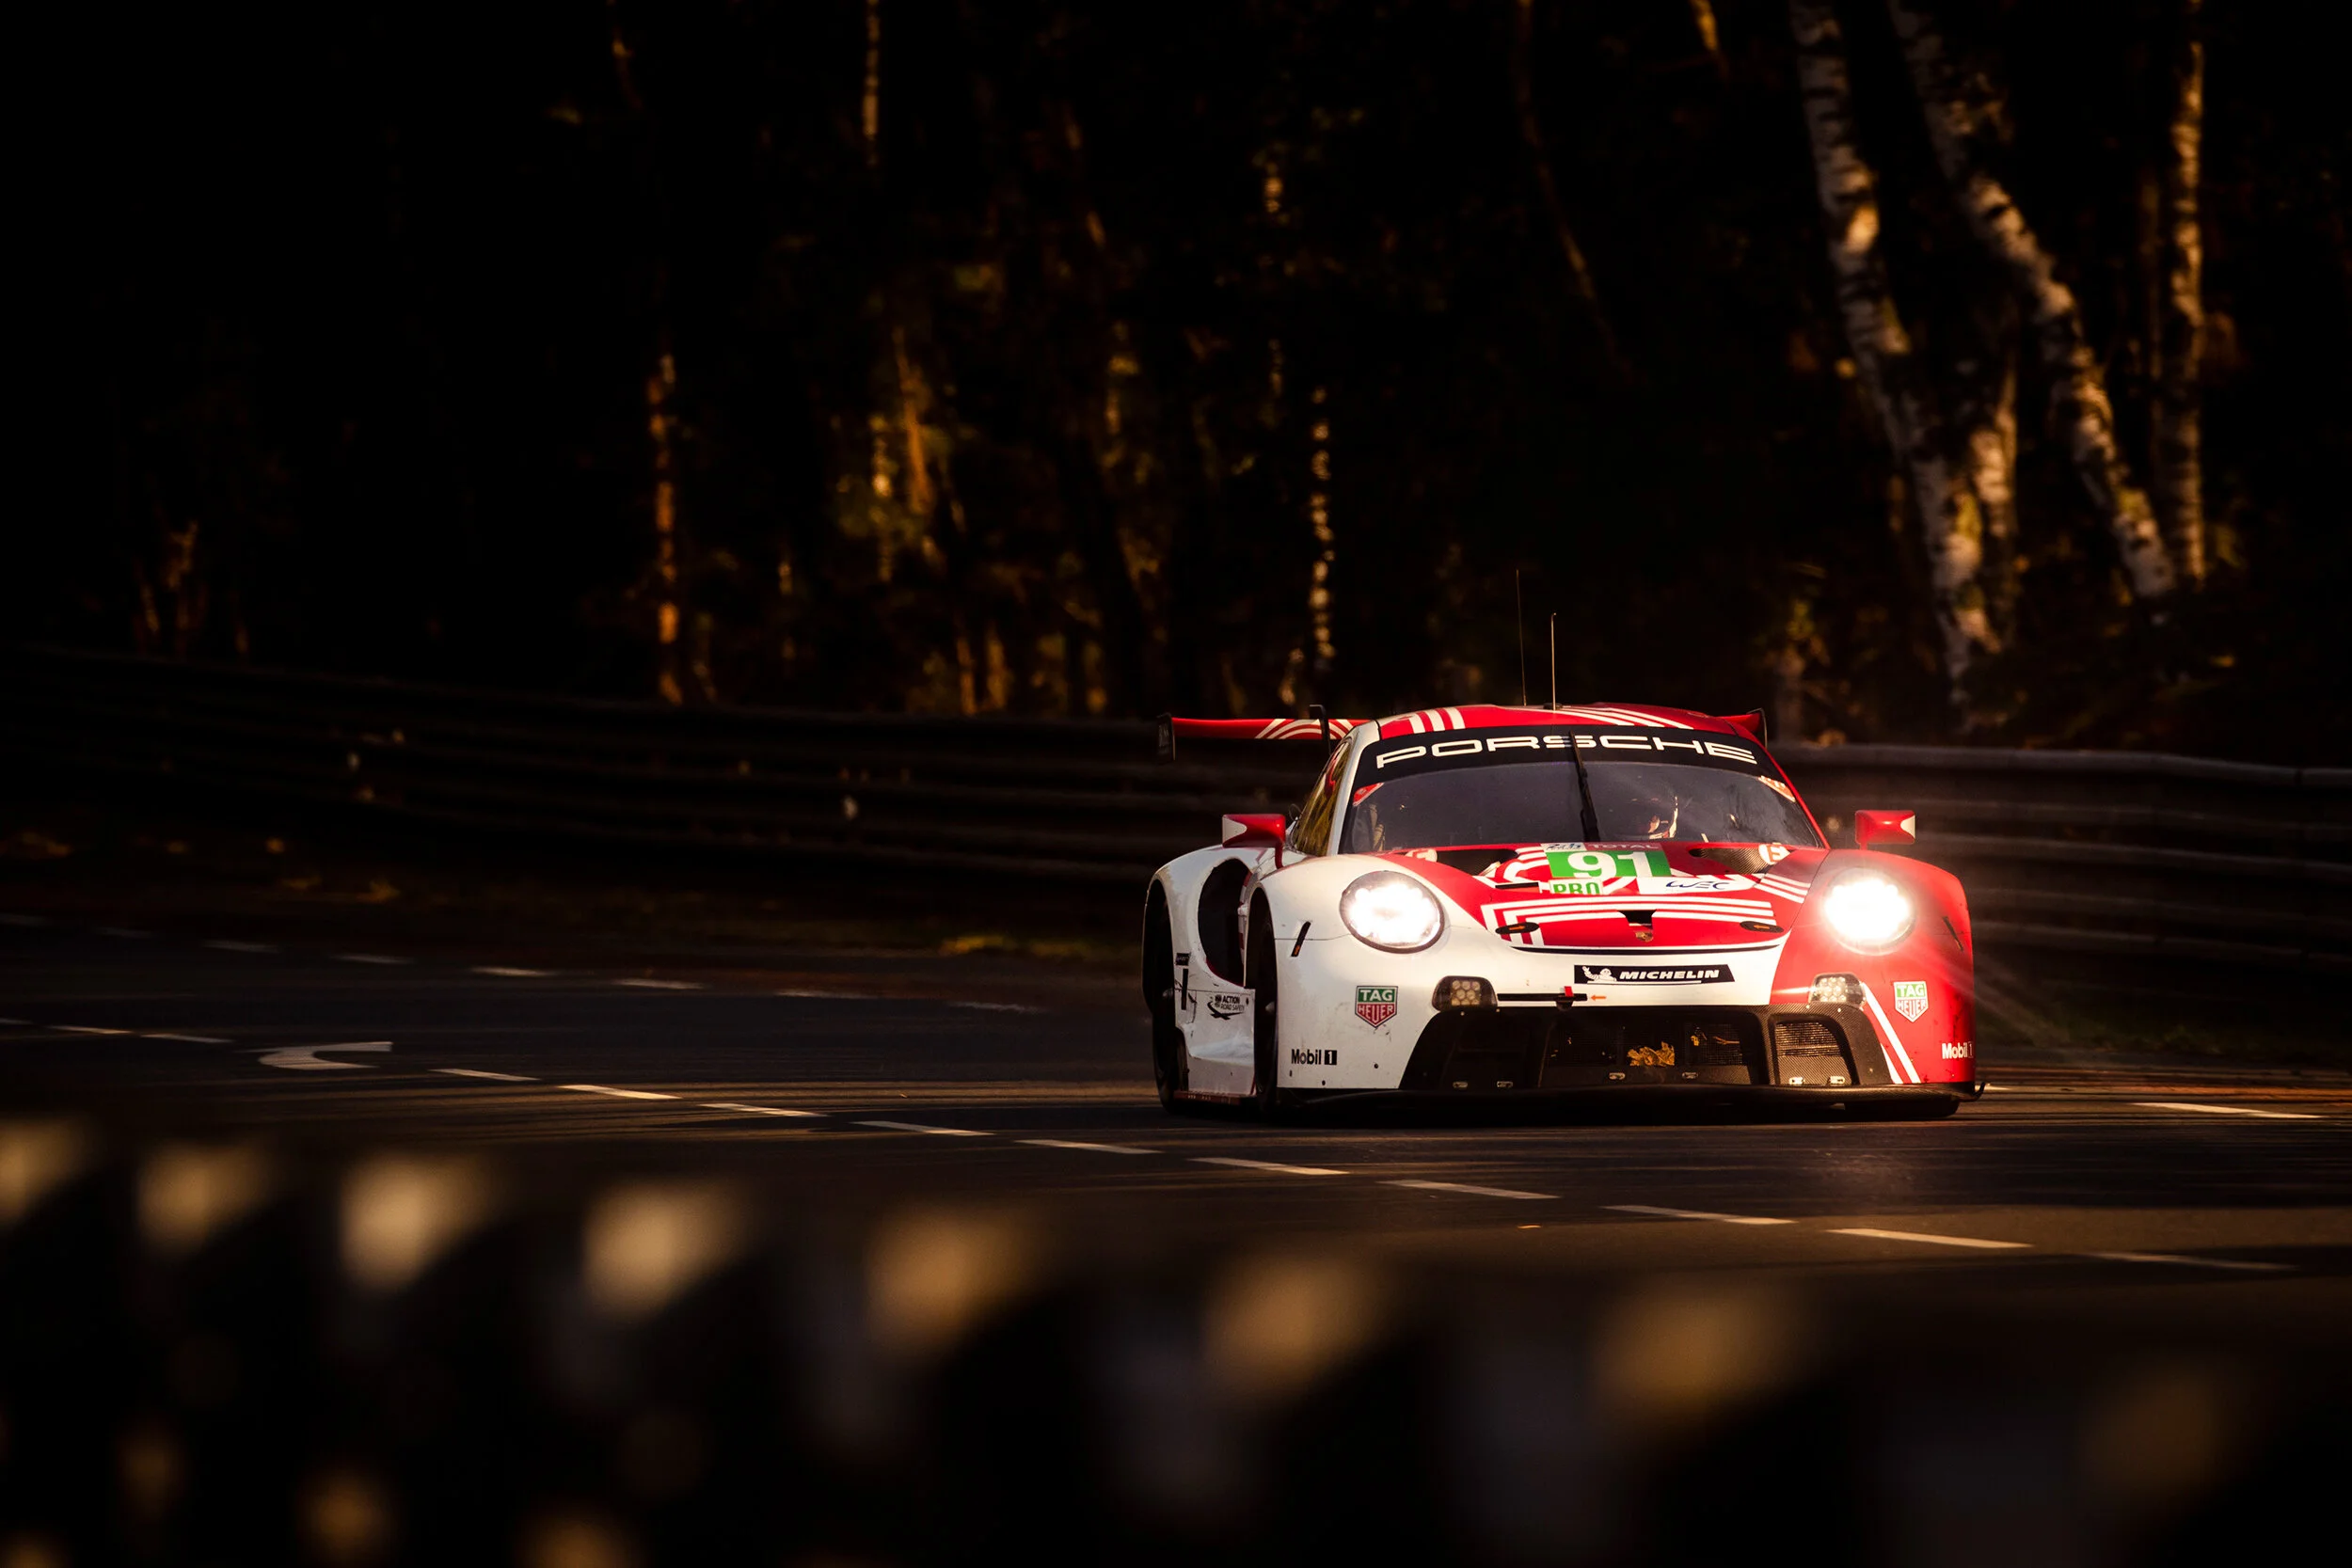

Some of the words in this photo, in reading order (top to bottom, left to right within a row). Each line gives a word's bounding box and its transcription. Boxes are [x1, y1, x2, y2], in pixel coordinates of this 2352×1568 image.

[1376, 735, 1757, 768] PORSCHE
[1567, 851, 1653, 878] 91
[1553, 882, 1600, 895] PRO
[1619, 970, 1720, 980] MICHELIN
[1360, 990, 1393, 1002] TAG
[1898, 985, 1925, 997] TAG
[1223, 995, 1240, 1004] ACTION
[1358, 1005, 1394, 1022] HEUER
[1898, 1000, 1927, 1017] HEUER
[1292, 1049, 1322, 1065] Mobil
[1942, 1042, 1967, 1059] Mobil
